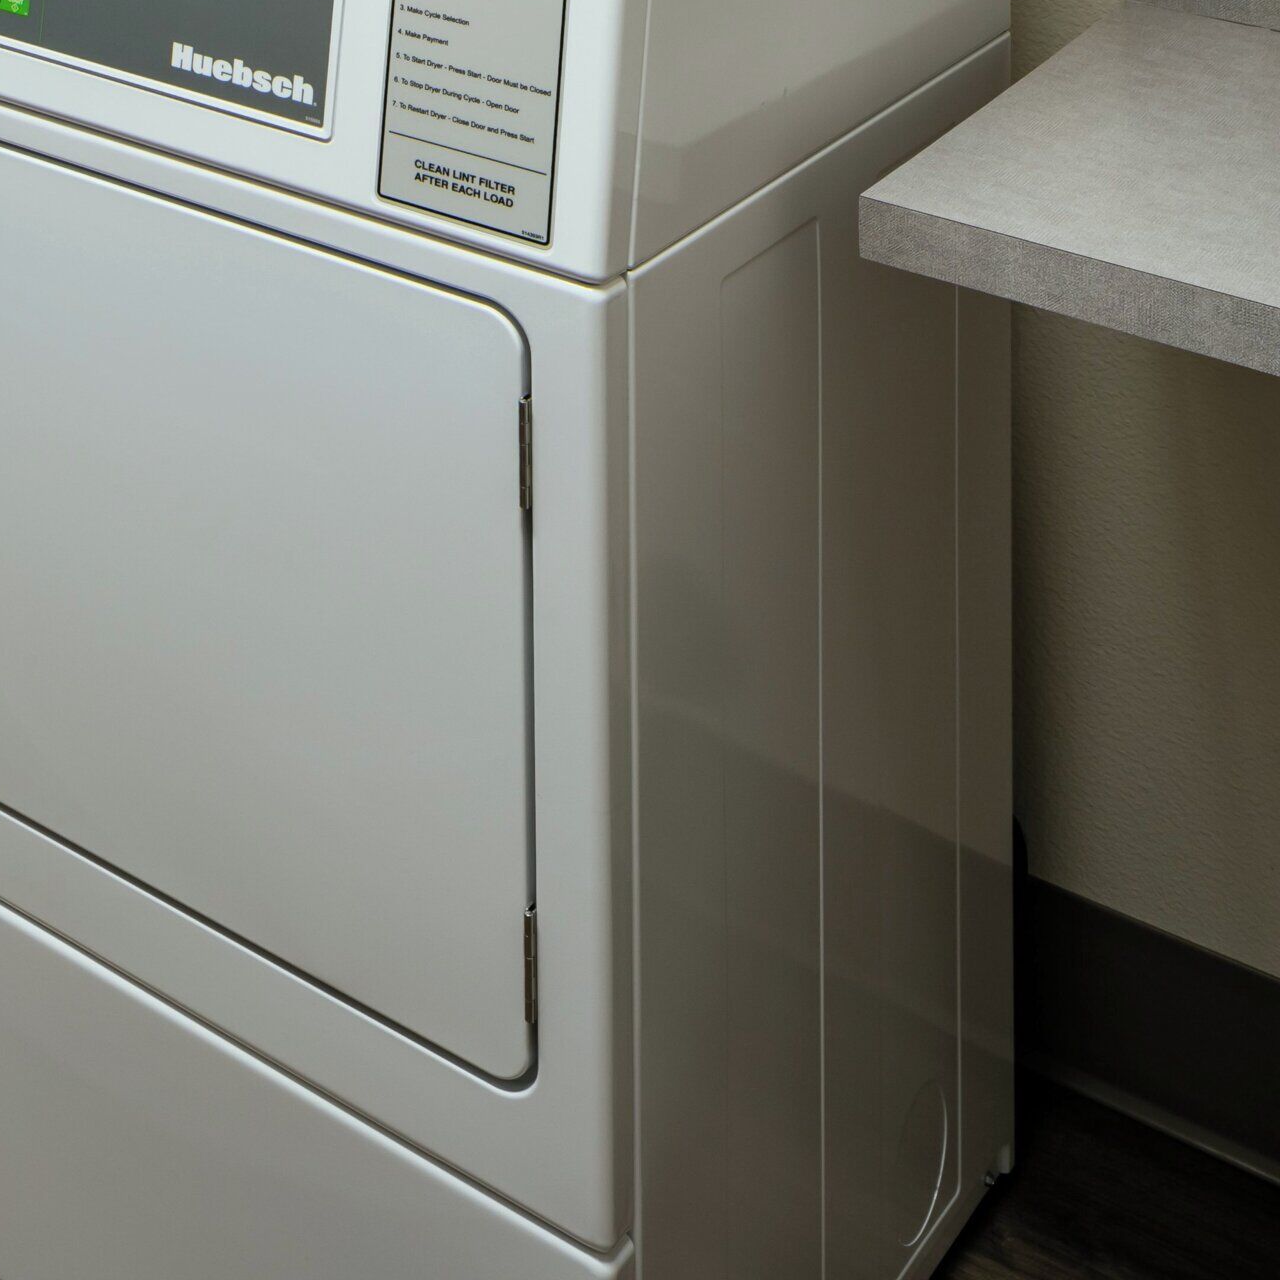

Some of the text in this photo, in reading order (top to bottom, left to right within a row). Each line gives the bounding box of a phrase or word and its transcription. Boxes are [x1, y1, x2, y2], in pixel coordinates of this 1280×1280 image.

[400, 4, 470, 26] 3. Make Cycle Selection
[398, 28, 448, 46] 4. Make Payment
[171, 41, 314, 106] Huebsch
[396, 52, 551, 97] 5. To Start Dryer Press Start Door Must be Closed
[401, 77, 408, 85] To
[410, 80, 424, 90] Stop
[424, 83, 441, 94] Dryer
[442, 88, 462, 101] During
[463, 93, 480, 104] Cycle
[486, 99, 503, 110] Open
[504, 104, 519, 114] Door
[399, 101, 407, 110] To
[408, 104, 429, 115] Restart
[430, 109, 447, 120] Dryer
[452, 116, 469, 126] Close
[470, 120, 485, 131] Door
[487, 125, 499, 134] and
[500, 128, 518, 139] Press
[519, 133, 534, 144] Start
[414, 159, 516, 195] CLEAN LINT FILTER
[414, 172, 514, 208] AFTER EACH LOAD
